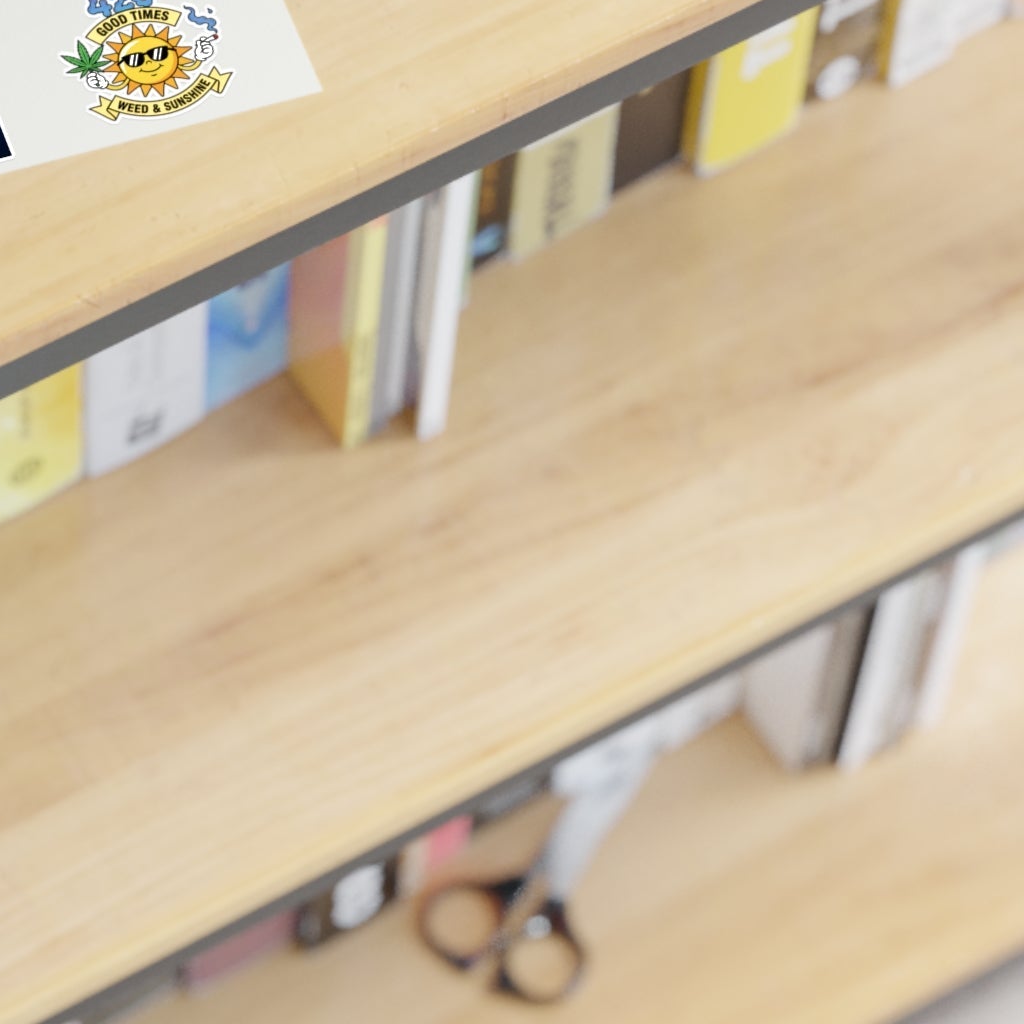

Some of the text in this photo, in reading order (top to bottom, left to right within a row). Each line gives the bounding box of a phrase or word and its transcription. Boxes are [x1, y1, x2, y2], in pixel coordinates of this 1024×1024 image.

[95, 9, 170, 38] GOOD TIMES
[117, 77, 212, 115] WEED & SUNSHINE
